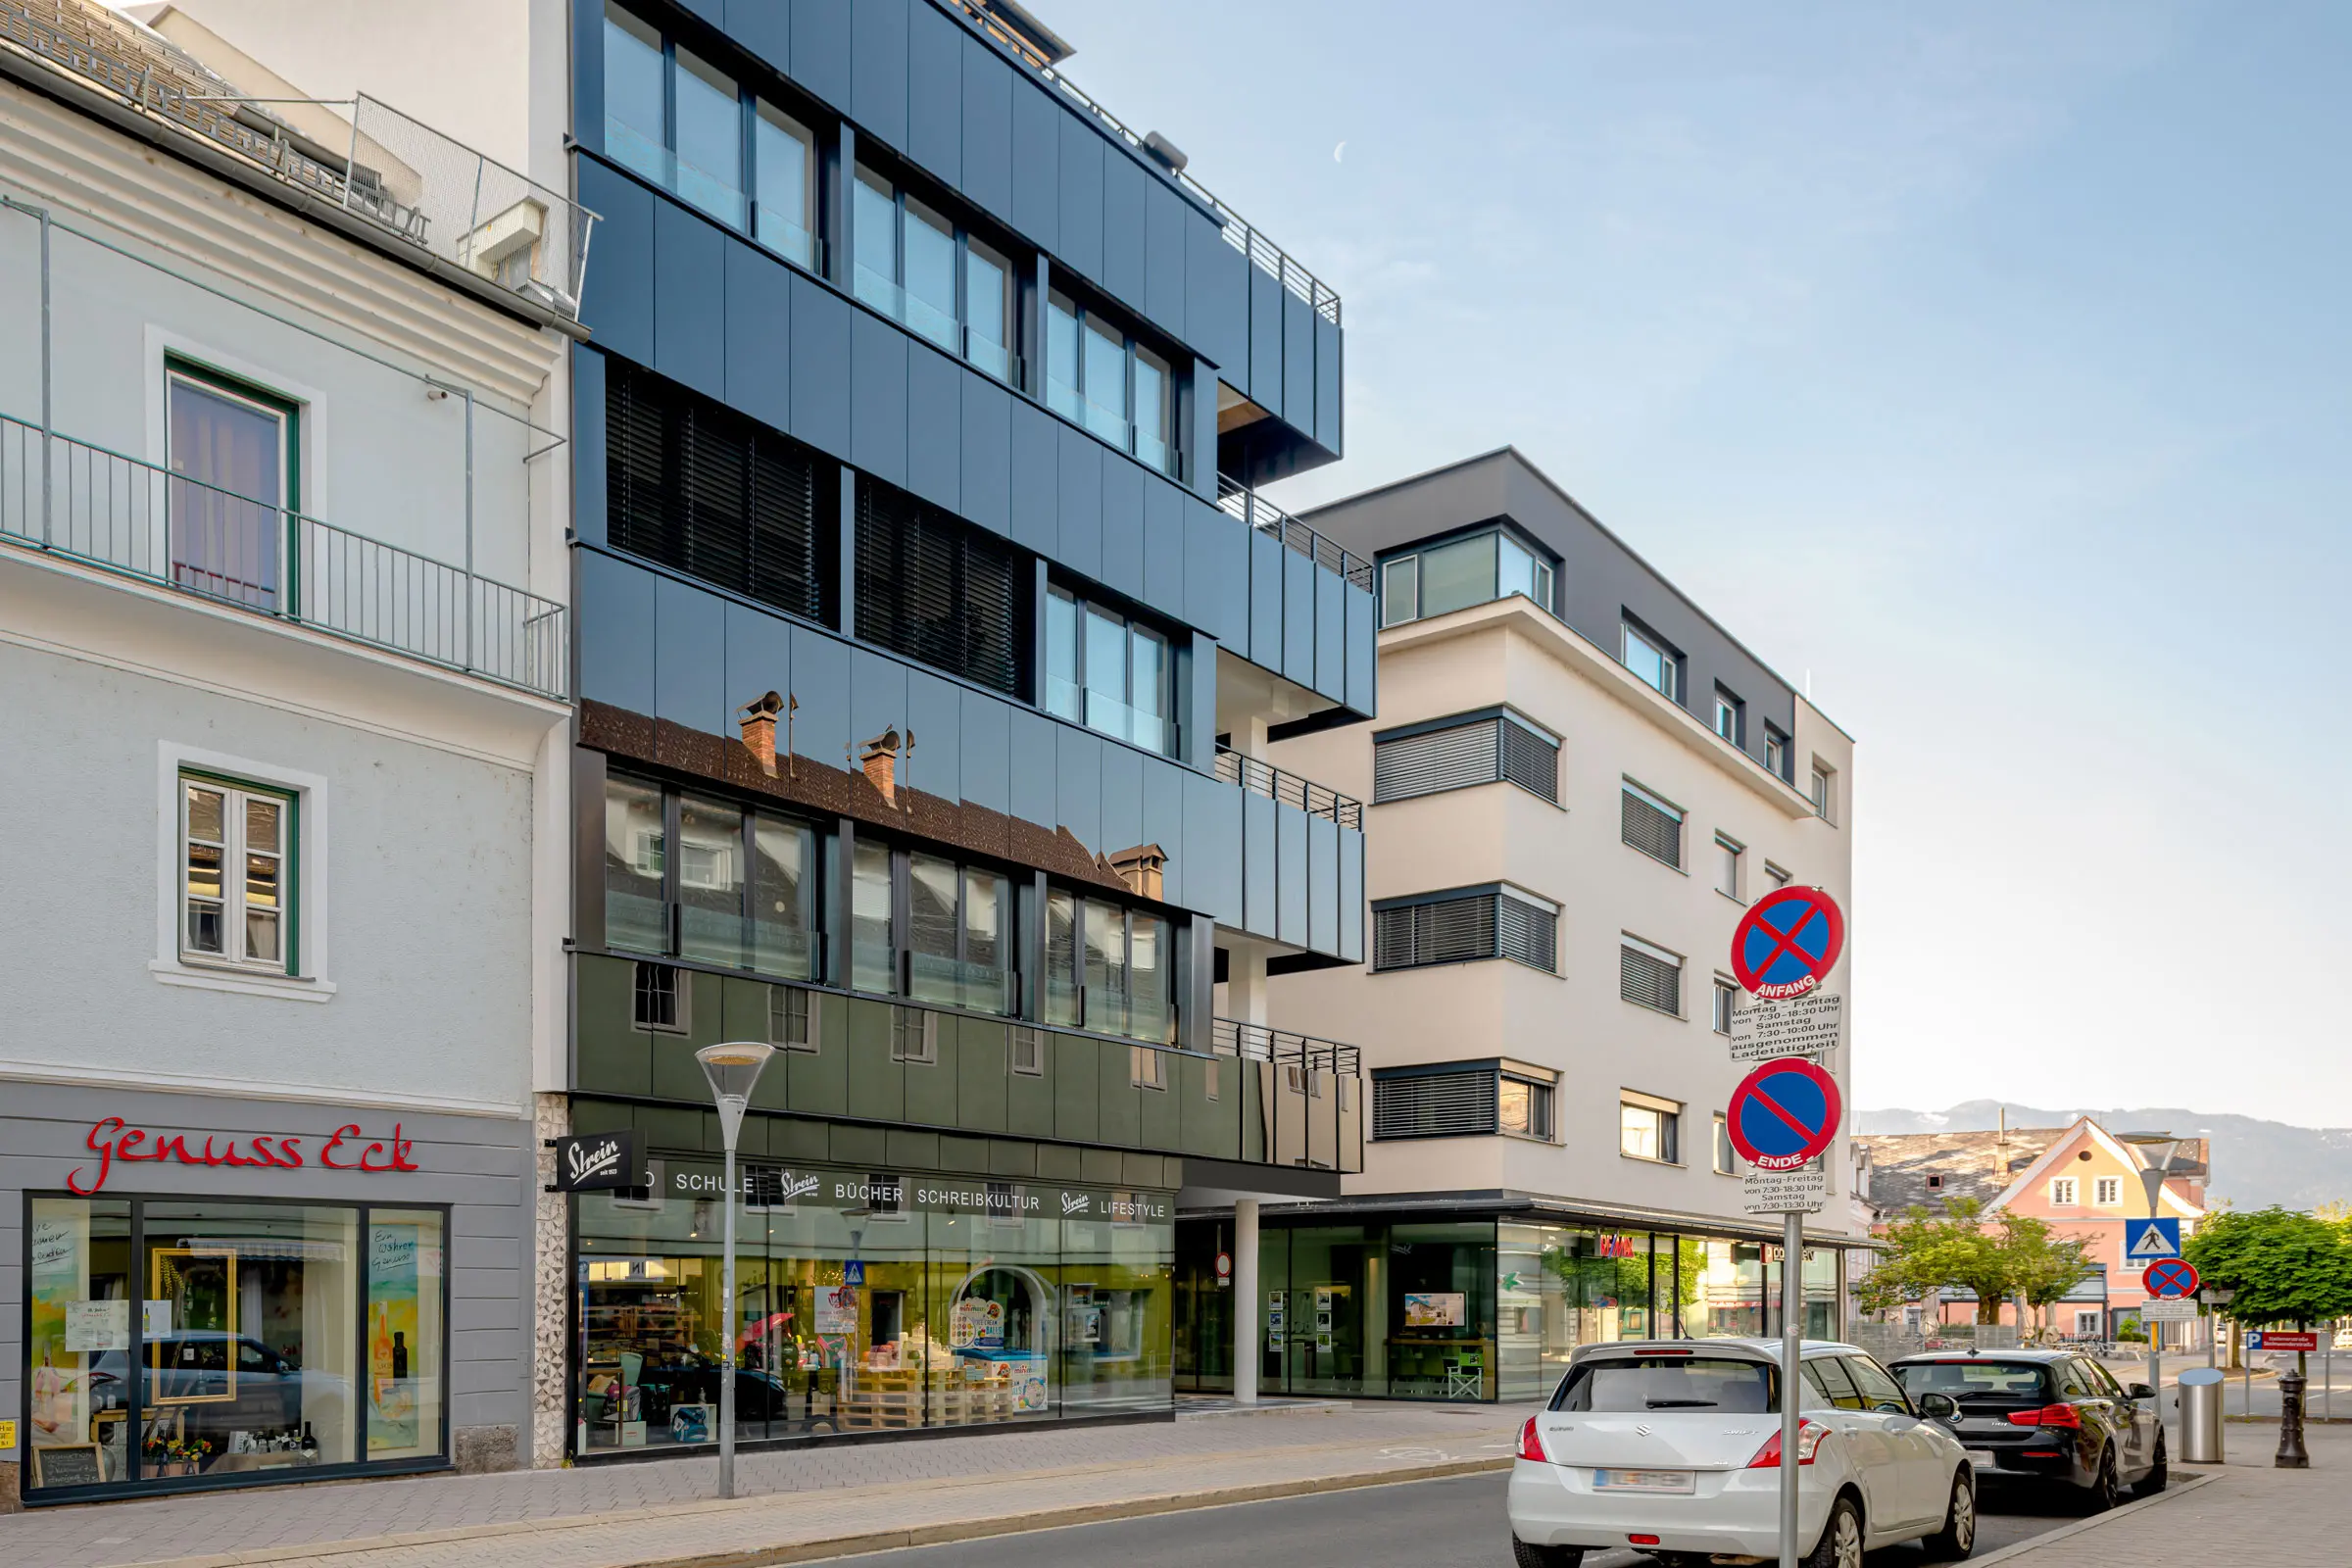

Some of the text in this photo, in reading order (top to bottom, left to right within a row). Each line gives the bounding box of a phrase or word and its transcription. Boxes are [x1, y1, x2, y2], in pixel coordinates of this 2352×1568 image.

[1756, 975, 1816, 997] ANFANG
[1732, 1005, 1777, 1017] Montag
[1793, 997, 1840, 1008] Freitag
[1756, 1017, 1811, 1030] Samstag
[1817, 1022, 1838, 1031] Uhr
[1731, 1032, 1838, 1051] ausgenommen
[1732, 1040, 1838, 1059] Ladetätigkeit
[67, 1116, 419, 1197] Genuss Eck
[1757, 1153, 1803, 1168] ENDE
[676, 1174, 754, 1193] SCHUE
[835, 1182, 904, 1202] BÜCHER
[917, 1189, 1039, 1210] SCHREIBKULTUR
[1101, 1200, 1164, 1217] LIFESTYLE
[1599, 1233, 1636, 1259] RE/MAX
